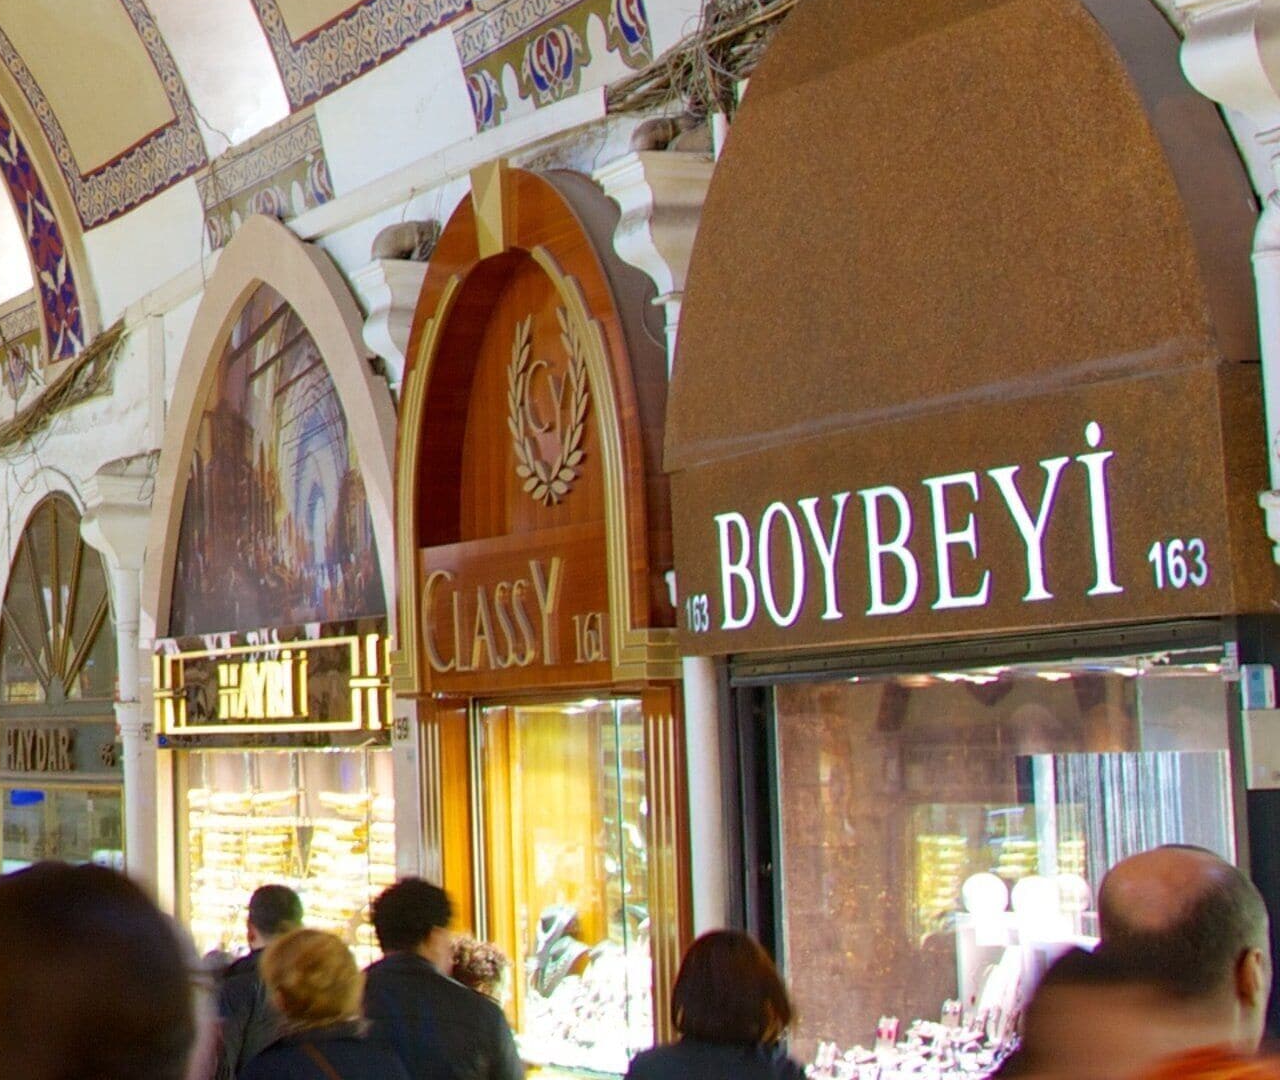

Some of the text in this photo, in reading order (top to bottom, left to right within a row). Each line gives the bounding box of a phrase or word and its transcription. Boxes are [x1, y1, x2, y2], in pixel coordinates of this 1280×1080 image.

[714, 420, 1125, 631] BOYBEYİ
[1147, 536, 1210, 590] 163
[572, 612, 608, 664] 161
[685, 593, 709, 632] 163
[6, 727, 74, 772] HAYDAR
